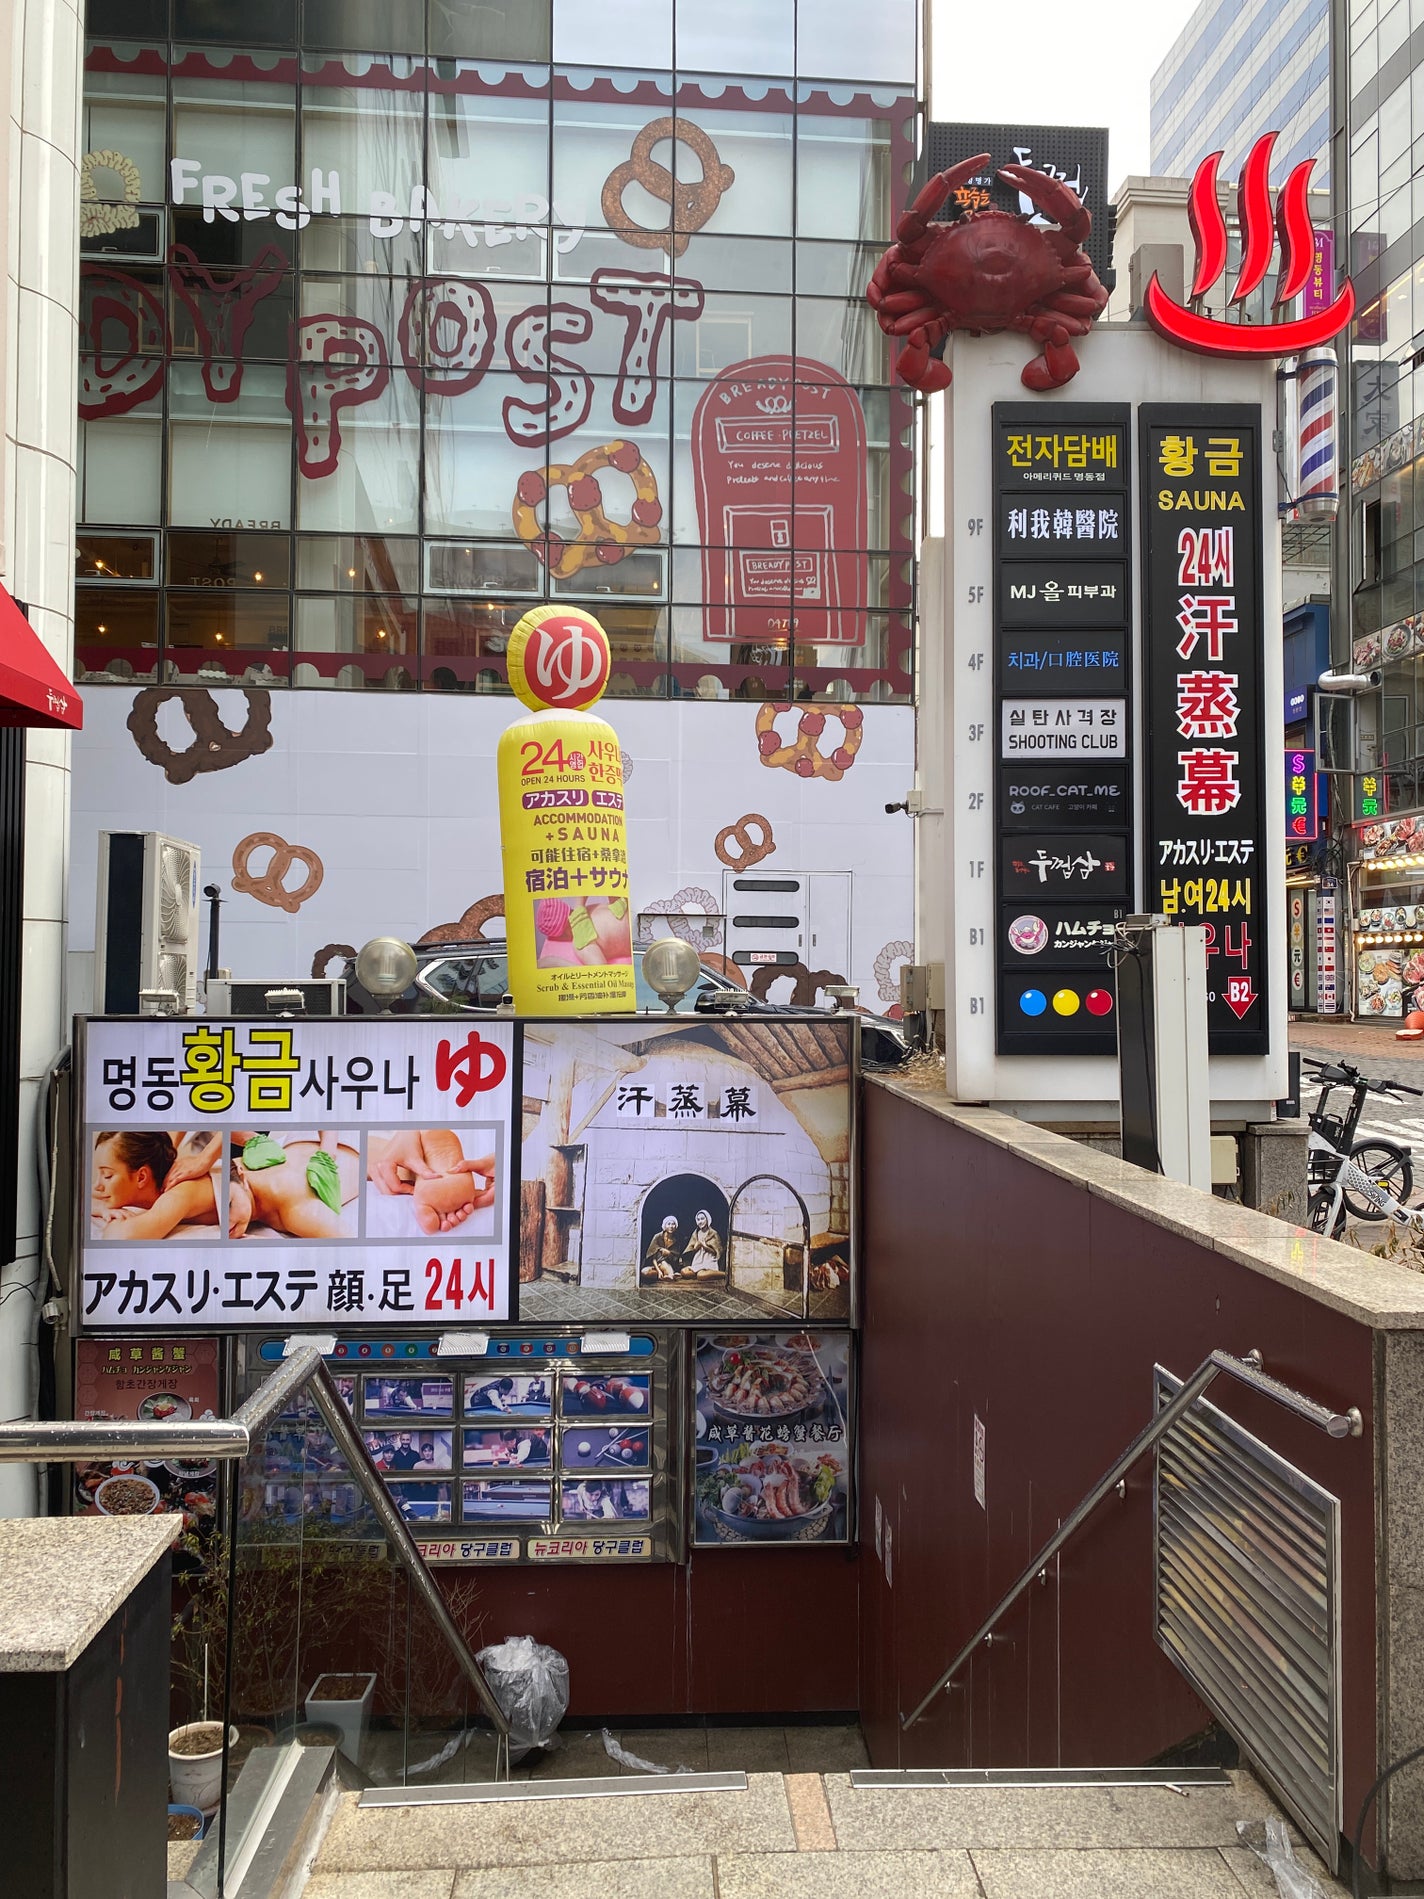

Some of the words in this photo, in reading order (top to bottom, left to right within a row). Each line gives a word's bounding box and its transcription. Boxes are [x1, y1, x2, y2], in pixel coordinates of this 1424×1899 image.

[169, 157, 340, 231] FRESH
[369, 184, 586, 255] BAKERY
[286, 268, 703, 479] POST
[736, 430, 774, 441] COFFEE
[1006, 433, 1117, 468] 전자담배
[1158, 435, 1244, 477] 황금
[1073, 472, 1105, 481] 명동점
[1158, 489, 1246, 511] SAUNA
[967, 518, 984, 536] 9F
[1007, 508, 1119, 539] 利我韓醫院
[1176, 526, 1234, 587] 24시
[784, 560, 808, 572] PST
[967, 585, 984, 603] 5F
[535, 626, 602, 700] ゆ
[968, 653, 984, 671] 4F
[1176, 593, 1242, 815] 汗蒸幕
[968, 723, 984, 741] 3F
[1008, 734, 1077, 749] SHOOTING
[1081, 734, 1118, 749] CLUB
[520, 739, 570, 777] 24
[521, 777, 541, 787] OPEN
[543, 775, 554, 784] 24
[556, 774, 586, 783] HOURS
[525, 790, 585, 809] アカスリ
[968, 792, 984, 809] 2F
[533, 812, 623, 827] ACCOMMODATION
[968, 860, 985, 878] 1F
[1113, 909, 1123, 919] B1
[969, 928, 985, 945] B1
[536, 982, 559, 993] Scrub
[561, 983, 569, 991] &
[572, 980, 606, 991] Essential
[1230, 982, 1250, 1002] B2
[969, 997, 985, 1014] B1
[435, 1030, 507, 1108] ゆ
[617, 1084, 757, 1122] 汗蒸幕
[424, 1258, 496, 1311] 24시
[417, 1543, 456, 1559] 코리아
[460, 1541, 513, 1558] 당구클럽
[534, 1541, 588, 1558] 뉴코리아
[592, 1539, 644, 1556] 당구클럽
